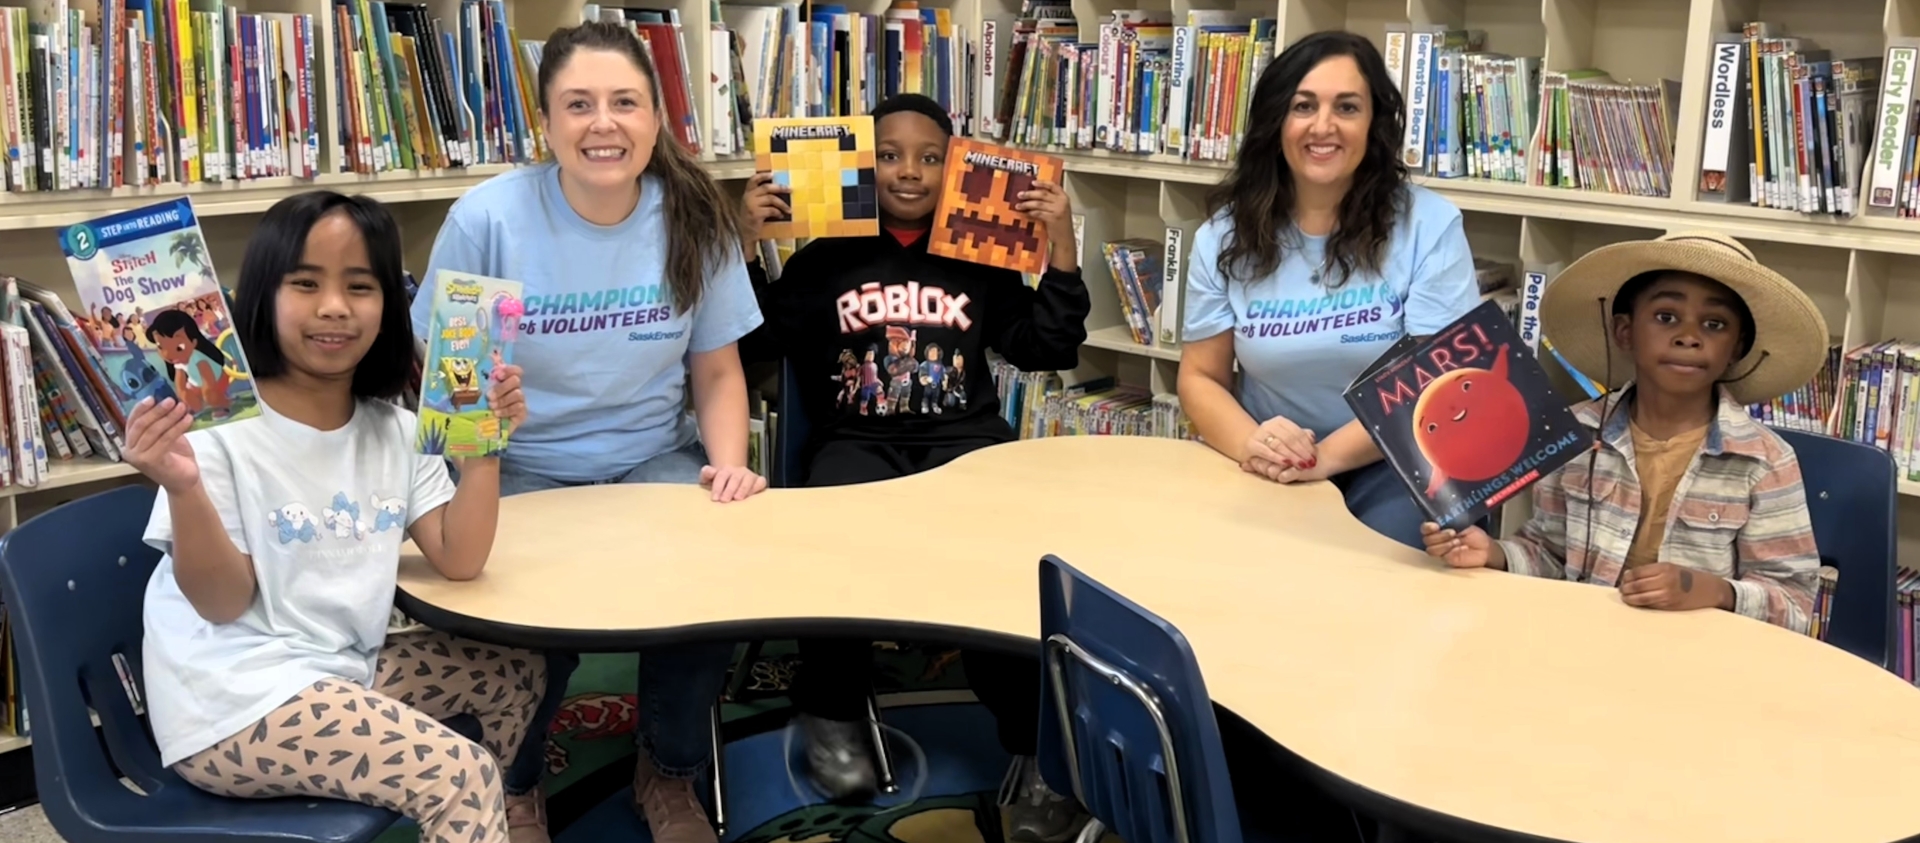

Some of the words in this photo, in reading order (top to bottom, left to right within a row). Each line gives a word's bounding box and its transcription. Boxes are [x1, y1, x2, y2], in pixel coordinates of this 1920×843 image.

[983, 22, 994, 77] Alphabet
[1101, 25, 1112, 76] Colours
[1172, 27, 1187, 88] Counting
[1415, 34, 1430, 105] Berenstain
[1711, 44, 1736, 130] Wordless
[1885, 49, 1912, 98] Early
[772, 124, 850, 140] MINECRAFT
[1410, 108, 1424, 146] Bears
[1879, 102, 1905, 171] Reader
[963, 150, 1040, 176] MINECRAFT
[76, 231, 89, 251] 2
[101, 224, 123, 239] STEP
[136, 209, 180, 230] READING
[1165, 228, 1180, 282] Franklin
[102, 285, 136, 305] Dog
[137, 273, 186, 297] Show
[113, 275, 134, 288] The
[1525, 273, 1543, 311] Pete
[523, 284, 664, 317] CHAMPION
[1245, 284, 1376, 320] CHAMPION
[518, 320, 536, 336] of
[541, 305, 671, 335] VOLUNTEERS
[628, 329, 685, 342] SaskEnergy
[1241, 323, 1256, 339] of
[1258, 306, 1382, 338] VOLUNTEERS
[1339, 330, 1401, 344] SaskEnergy
[1522, 315, 1538, 341] the
[1376, 322, 1494, 417] MARS!
[1436, 473, 1512, 527] EARTHLINGS
[1509, 430, 1579, 476] WELCOME
